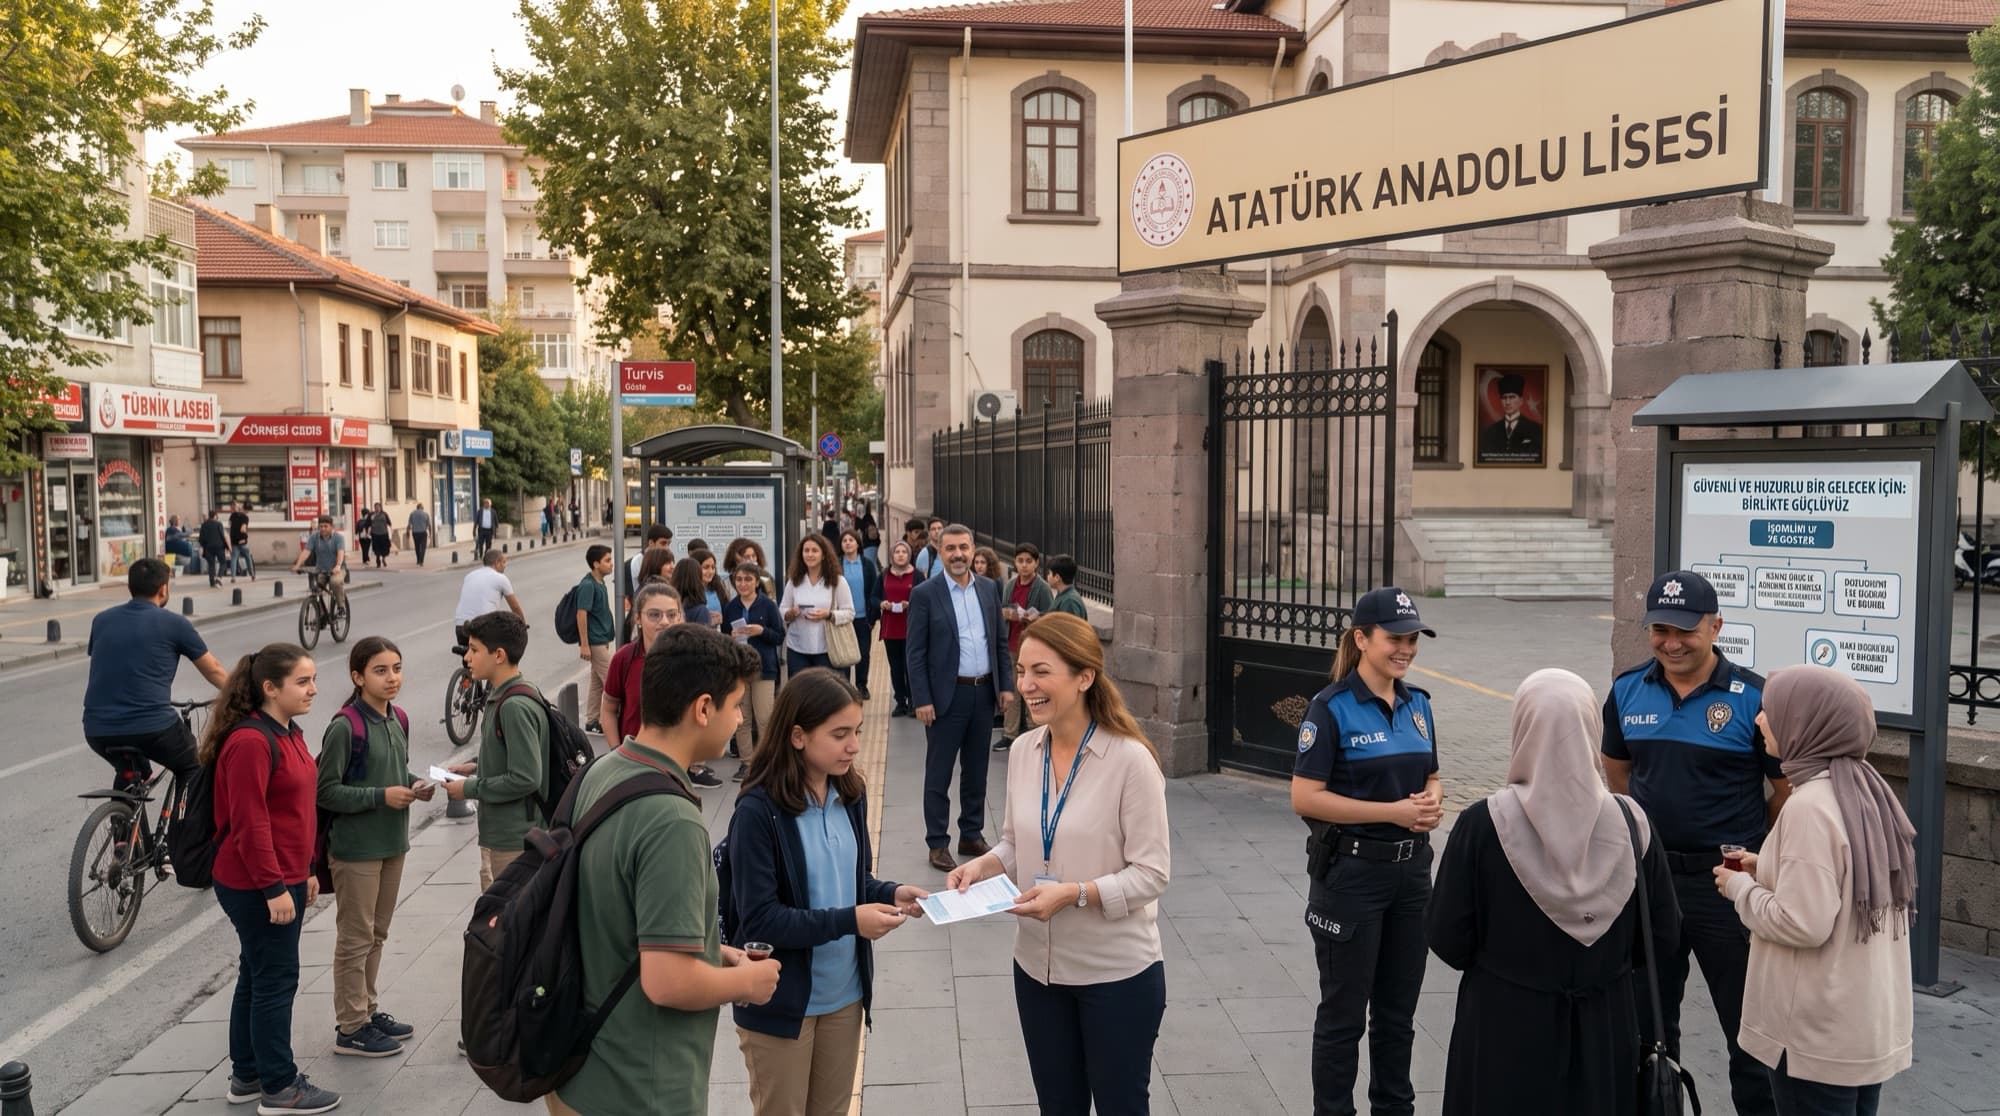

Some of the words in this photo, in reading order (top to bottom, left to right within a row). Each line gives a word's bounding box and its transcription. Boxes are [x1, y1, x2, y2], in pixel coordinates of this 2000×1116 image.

[1206, 171, 1363, 236] ATATÜRK
[1372, 136, 1567, 210] ANADOLU
[1583, 94, 1728, 177] LİSESİ
[624, 367, 664, 380] Turvis
[173, 397, 213, 420] LASEBİ
[1693, 478, 1737, 493] GÜVENLİ
[1739, 481, 1752, 493] VE
[1754, 481, 1804, 494] HUZURLU
[1806, 478, 1825, 494] BİR
[1827, 480, 1875, 495] GELECEK
[1878, 478, 1907, 498] İÇİN:
[1742, 495, 1789, 511] BİRLİKTE
[1791, 496, 1849, 515] GÜÇLÜYÜZ
[1624, 714, 1659, 727] POLIE
[1350, 731, 1388, 748] POLIE
